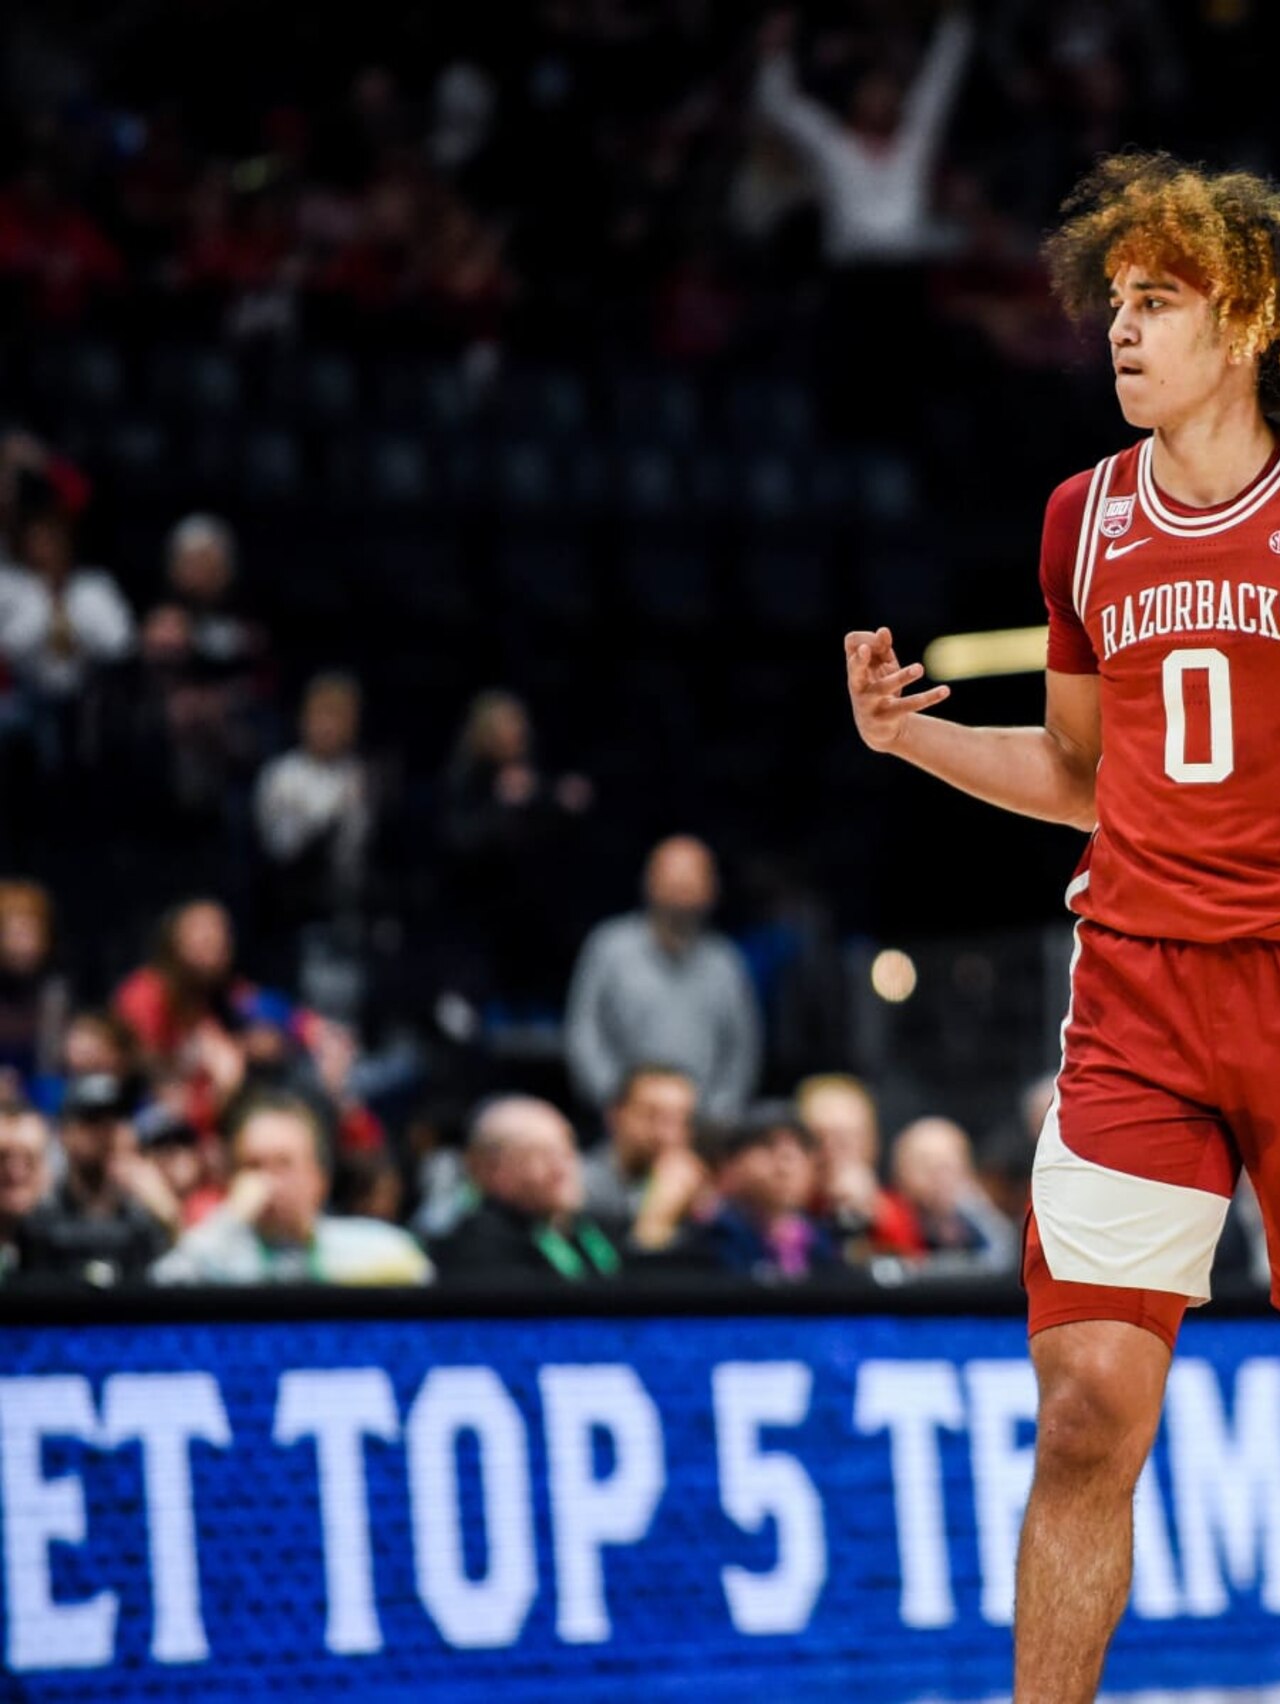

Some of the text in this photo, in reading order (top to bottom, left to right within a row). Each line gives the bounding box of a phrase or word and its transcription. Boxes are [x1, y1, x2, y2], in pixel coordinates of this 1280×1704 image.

[1162, 648, 1234, 783] 0
[272, 1362, 667, 1656] TOP
[711, 1360, 827, 1635] 5
